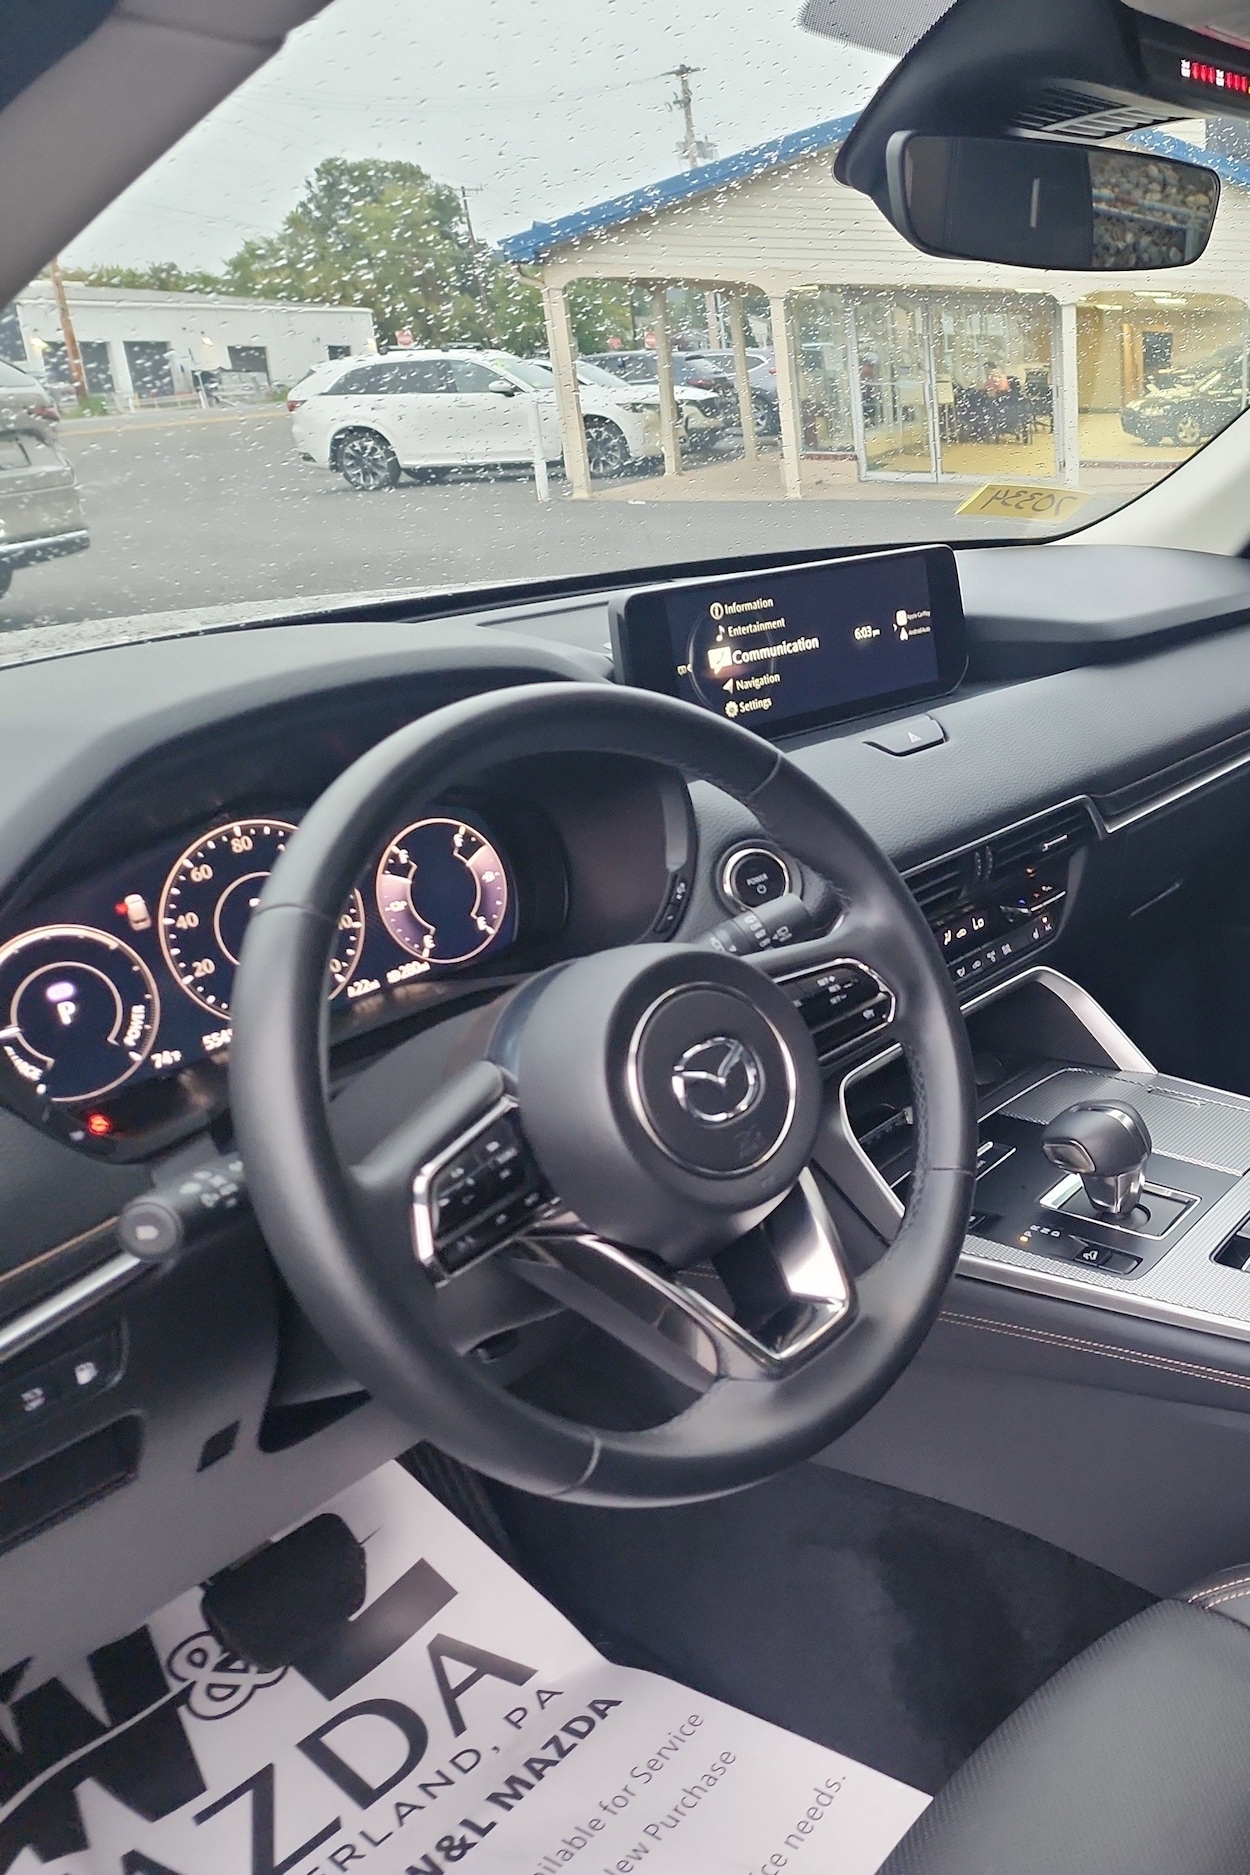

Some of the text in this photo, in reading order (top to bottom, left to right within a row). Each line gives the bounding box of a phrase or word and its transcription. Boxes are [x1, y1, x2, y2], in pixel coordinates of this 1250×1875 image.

[724, 598, 774, 615] Information
[728, 617, 786, 638] Entertainment
[732, 637, 819, 664] Communication
[736, 674, 781, 691] Navigation
[739, 698, 772, 714] Settings
[231, 836, 253, 853] 80
[190, 863, 213, 882] 60
[176, 912, 199, 930] 40
[192, 958, 216, 976] 20
[57, 1001, 76, 1026] P
[1050, 1230, 1061, 1238] D
[115, 1633, 538, 1875] ZDA
[485, 1698, 623, 1812] MAZDA
[599, 1784, 636, 1816] for
[630, 1712, 704, 1785] Service
[304, 1688, 566, 1875] RLAND, PA
[642, 1748, 737, 1841] Purchase
[784, 1774, 847, 1850] needs.
